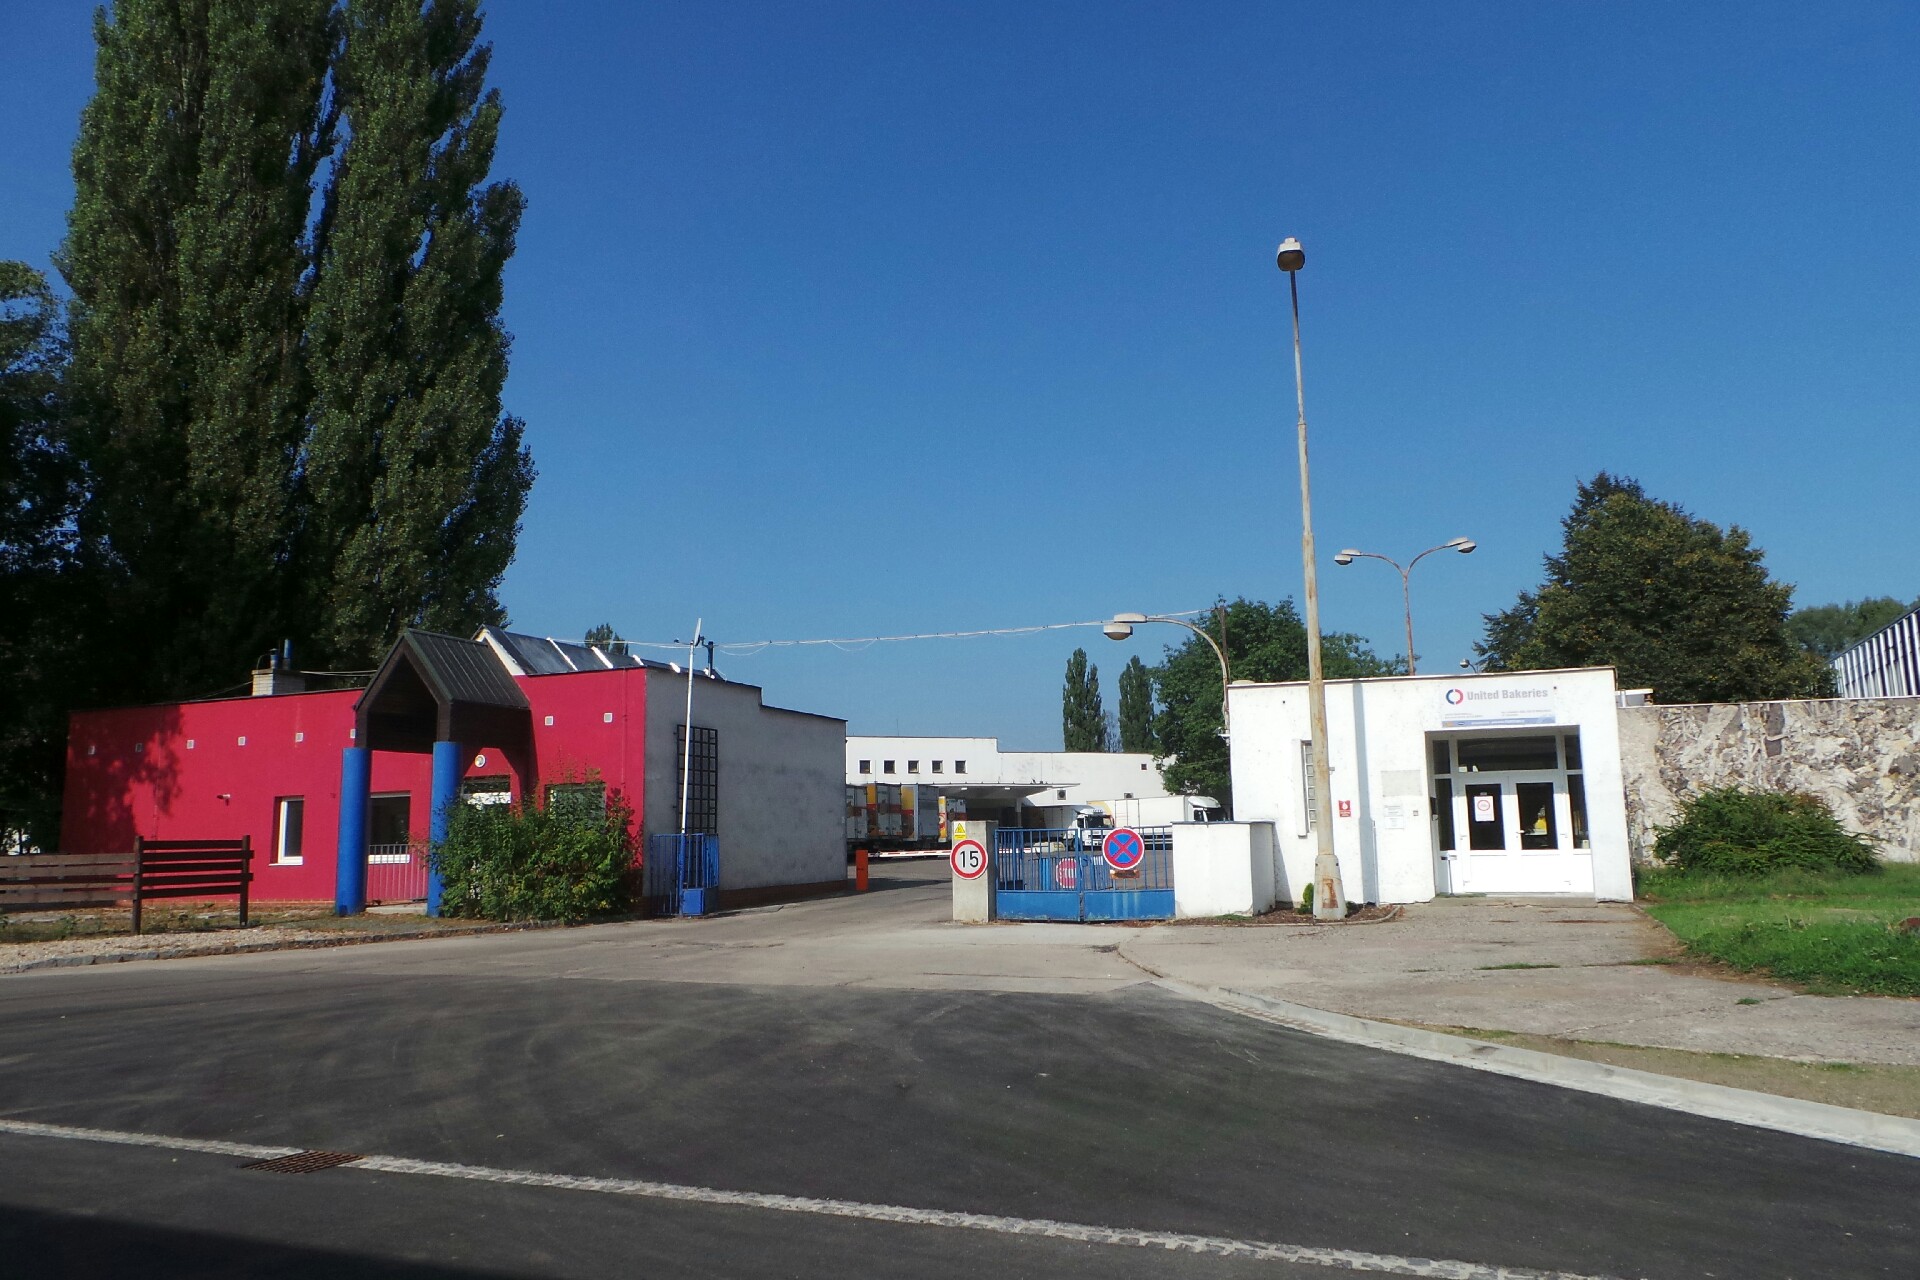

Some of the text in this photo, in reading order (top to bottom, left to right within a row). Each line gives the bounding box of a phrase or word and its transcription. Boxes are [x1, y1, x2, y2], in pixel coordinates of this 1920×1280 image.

[1467, 688, 1548, 701] United Bakeries
[960, 850, 979, 868] 15
